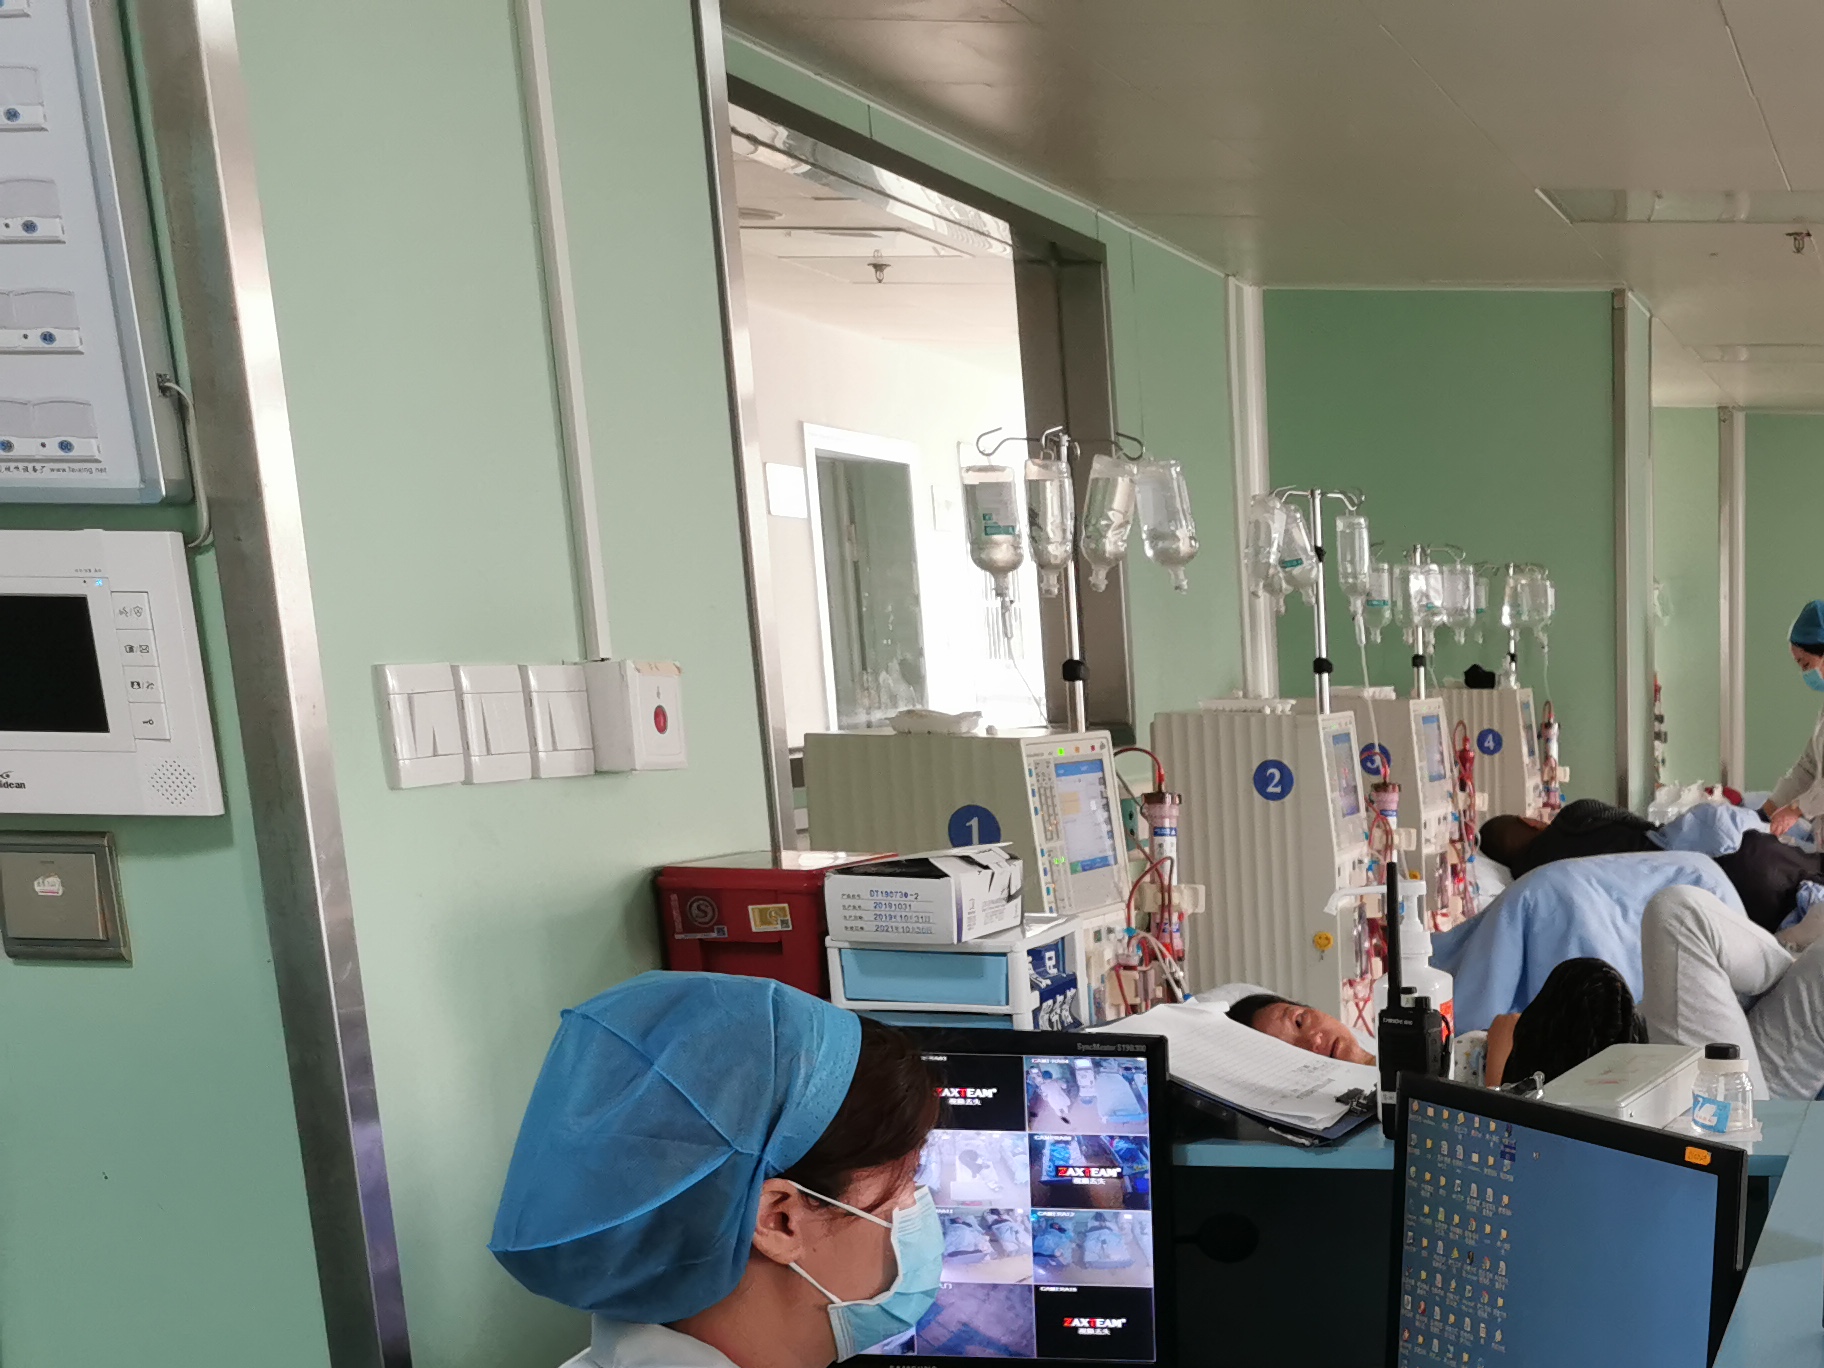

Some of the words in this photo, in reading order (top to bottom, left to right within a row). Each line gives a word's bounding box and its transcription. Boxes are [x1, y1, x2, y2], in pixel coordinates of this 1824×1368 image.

[1483, 734, 1495, 750] 4
[1265, 767, 1282, 793] 2
[965, 816, 980, 846] 1
